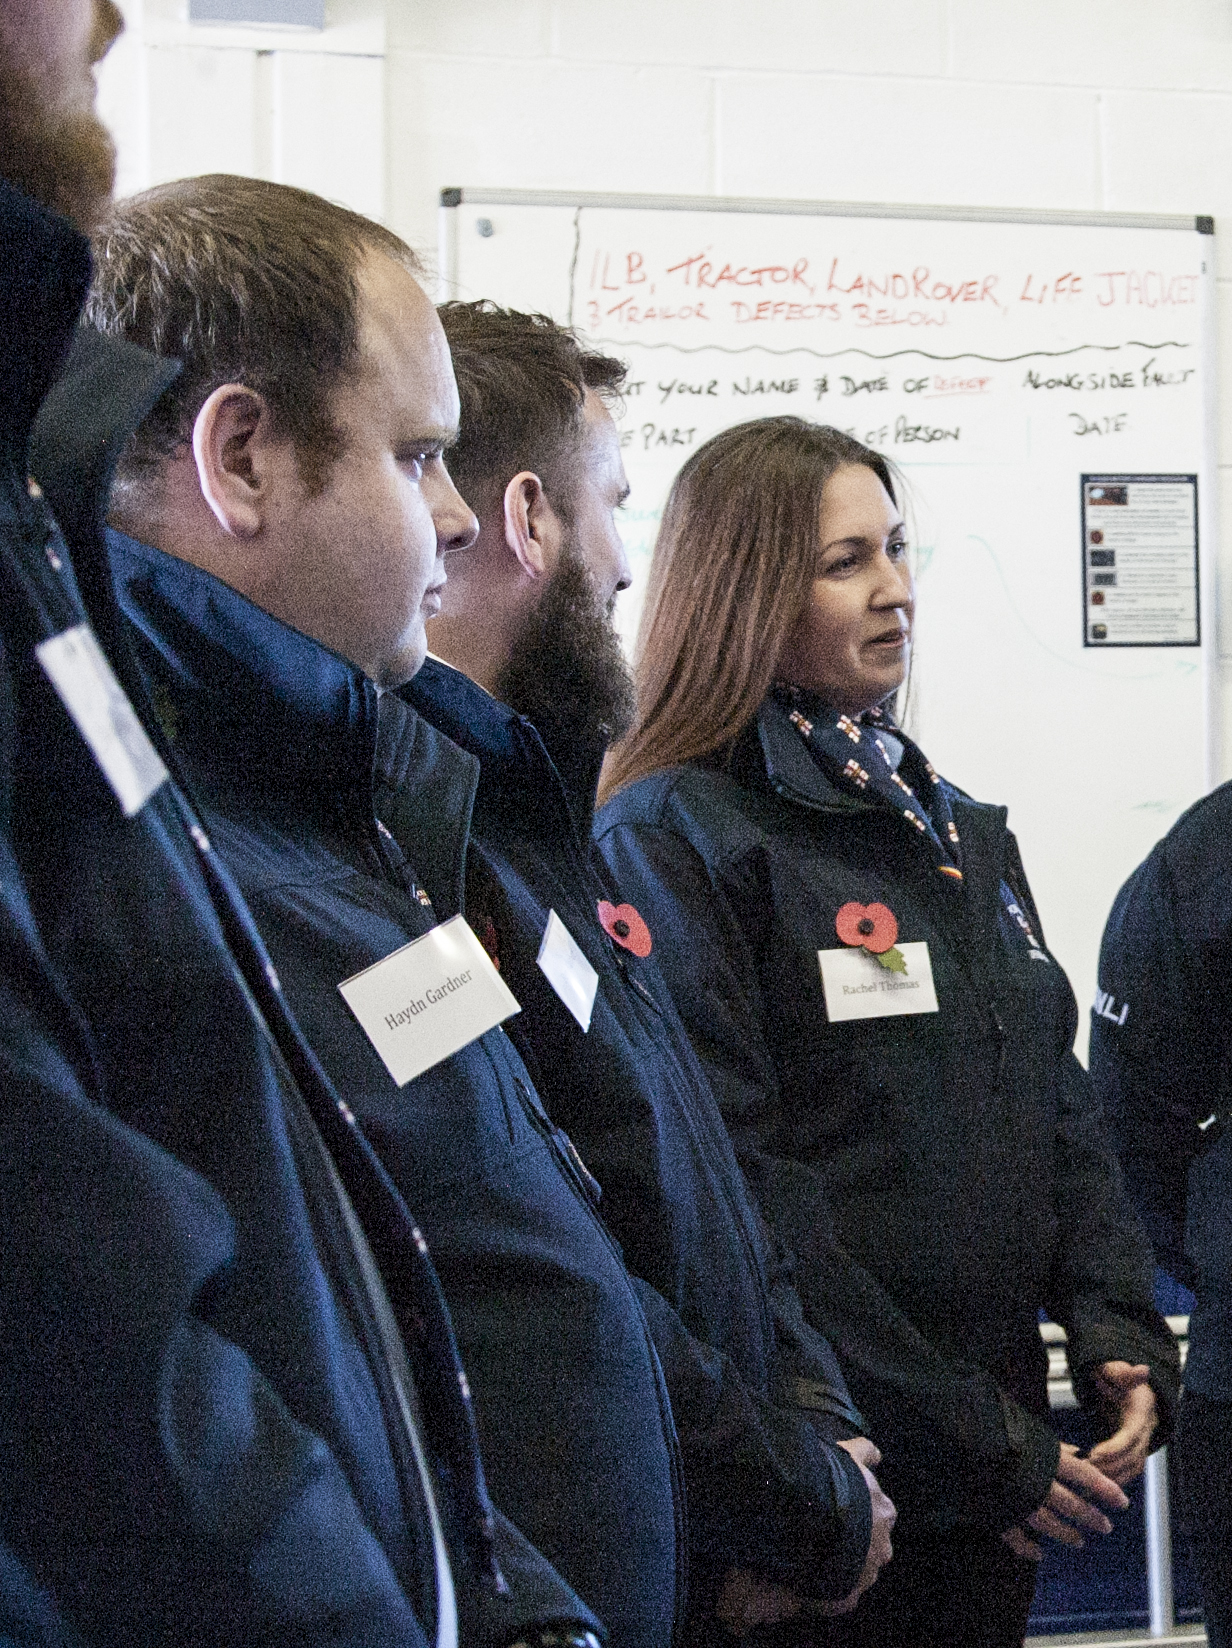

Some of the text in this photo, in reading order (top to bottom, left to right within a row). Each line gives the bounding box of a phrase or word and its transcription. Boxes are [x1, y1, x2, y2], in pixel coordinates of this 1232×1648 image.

[1094, 268, 1199, 308] JACKET
[731, 300, 842, 325] DEFECTS
[851, 302, 948, 328] BELOW
[657, 378, 719, 404] YOUR
[732, 376, 800, 397] NAME
[839, 375, 889, 397] DATE
[903, 376, 930, 394] OF
[641, 422, 698, 451] PART
[894, 414, 961, 445] PERSON
[1068, 411, 1129, 437] DATE
[384, 969, 473, 1031] Haydn Gardner
[842, 980, 920, 996] Rachel Thomas
